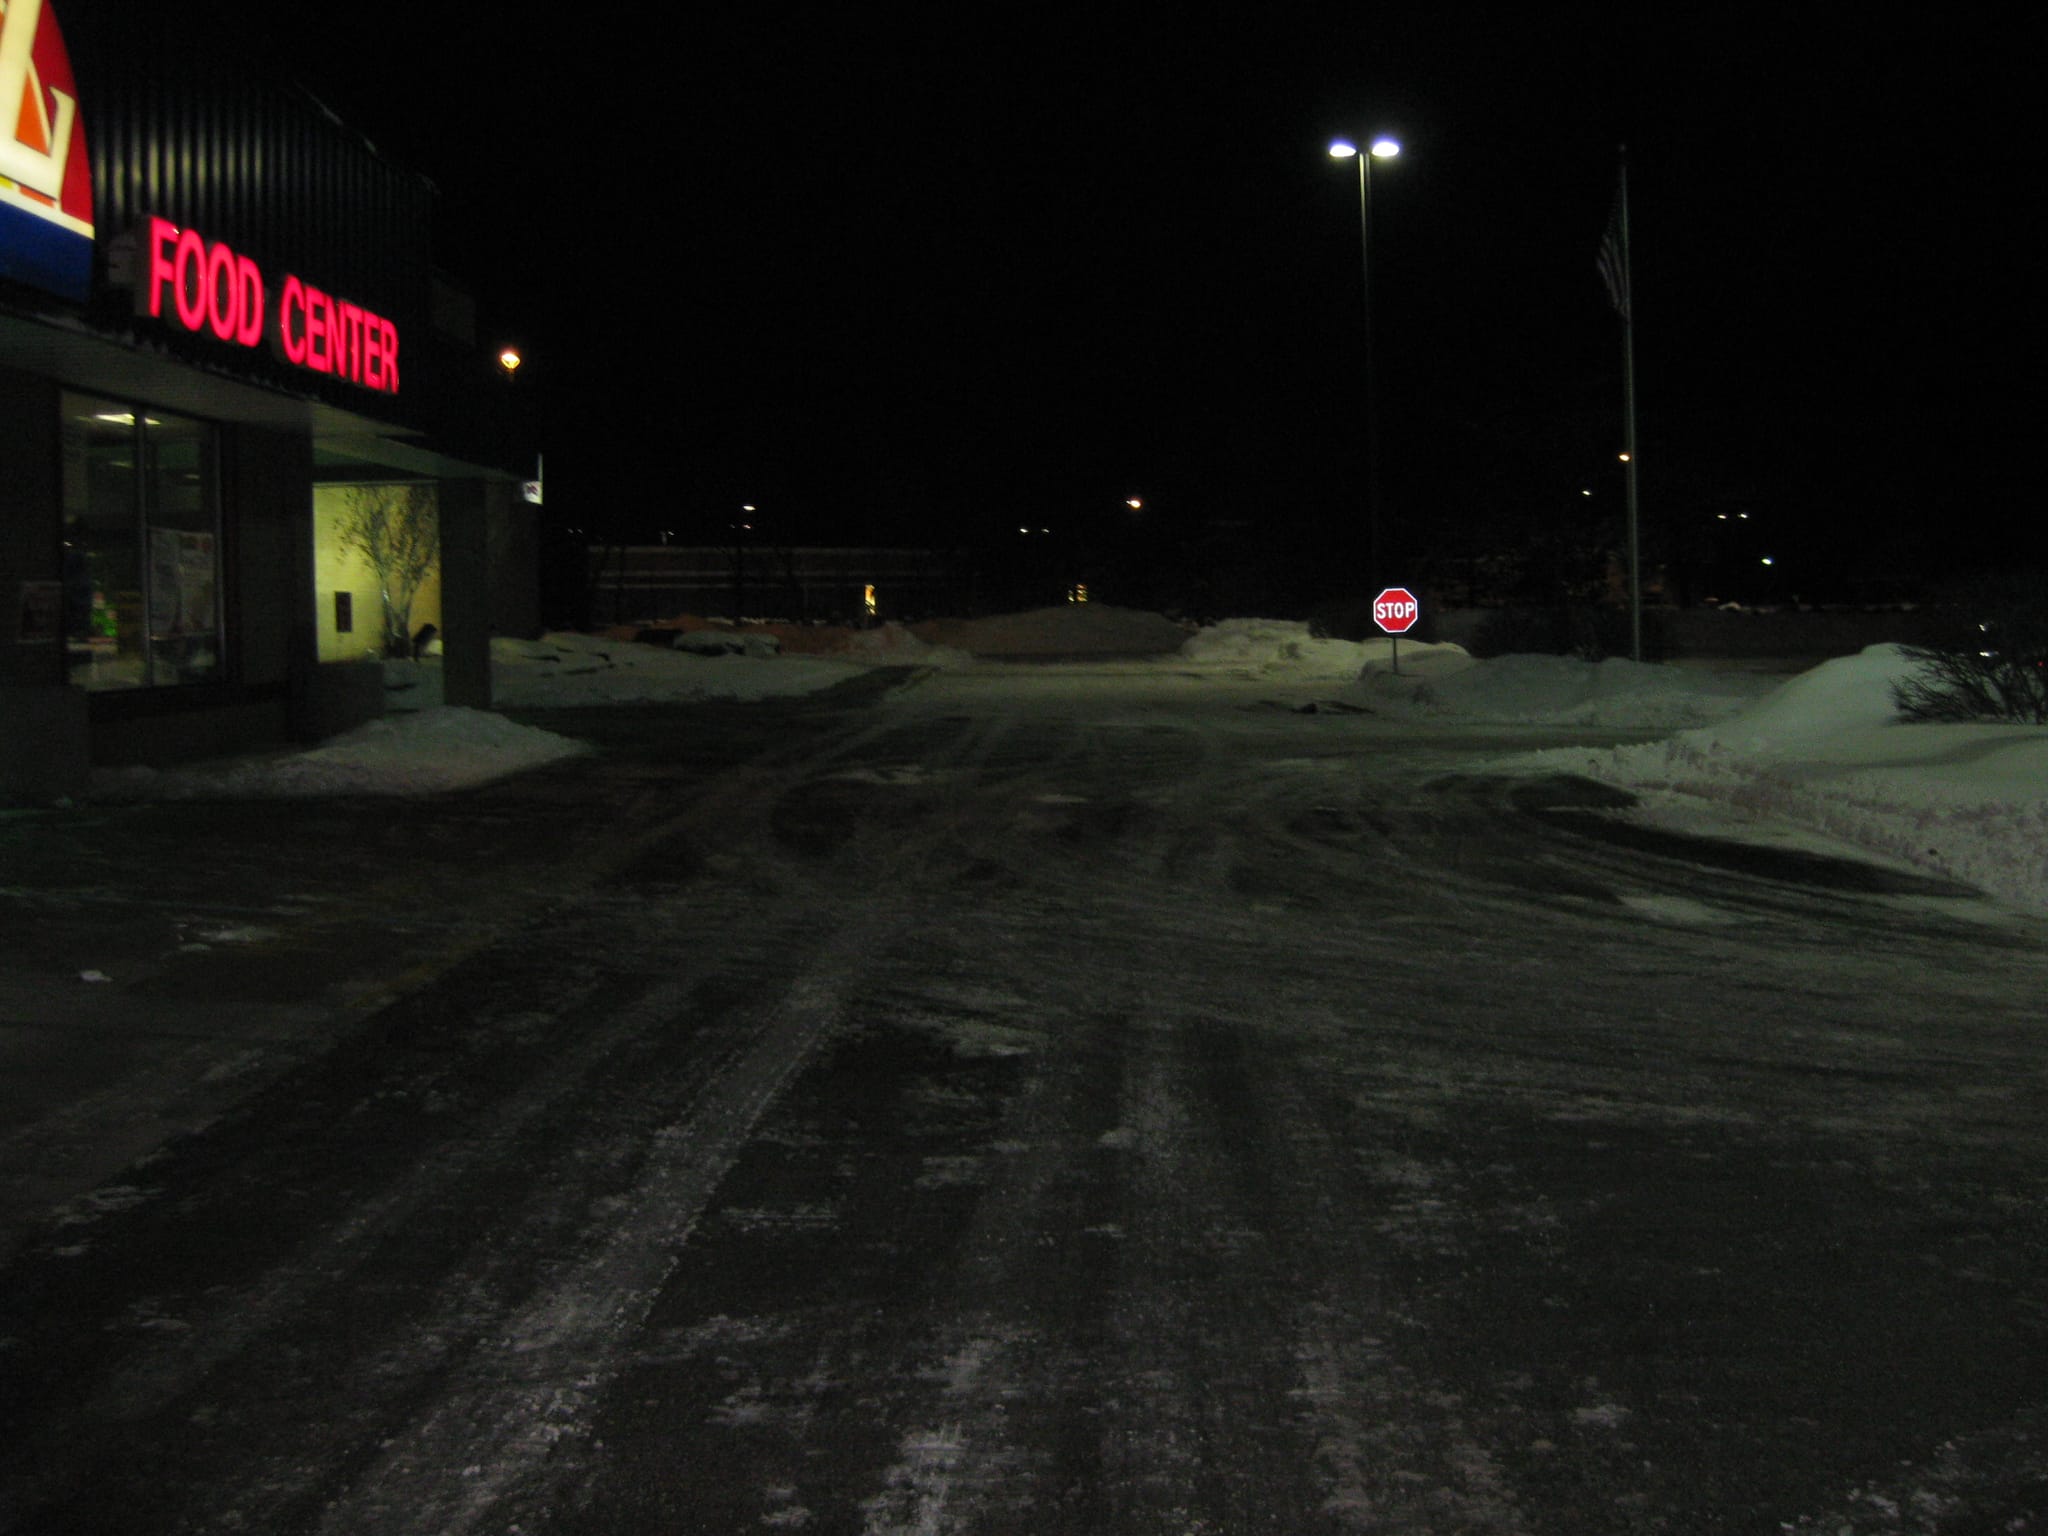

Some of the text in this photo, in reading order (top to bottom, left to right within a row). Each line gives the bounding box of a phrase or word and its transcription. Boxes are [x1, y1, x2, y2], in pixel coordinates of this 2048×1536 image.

[150, 216, 399, 394] FOOD CENTER
[1376, 602, 1415, 619] STOP
